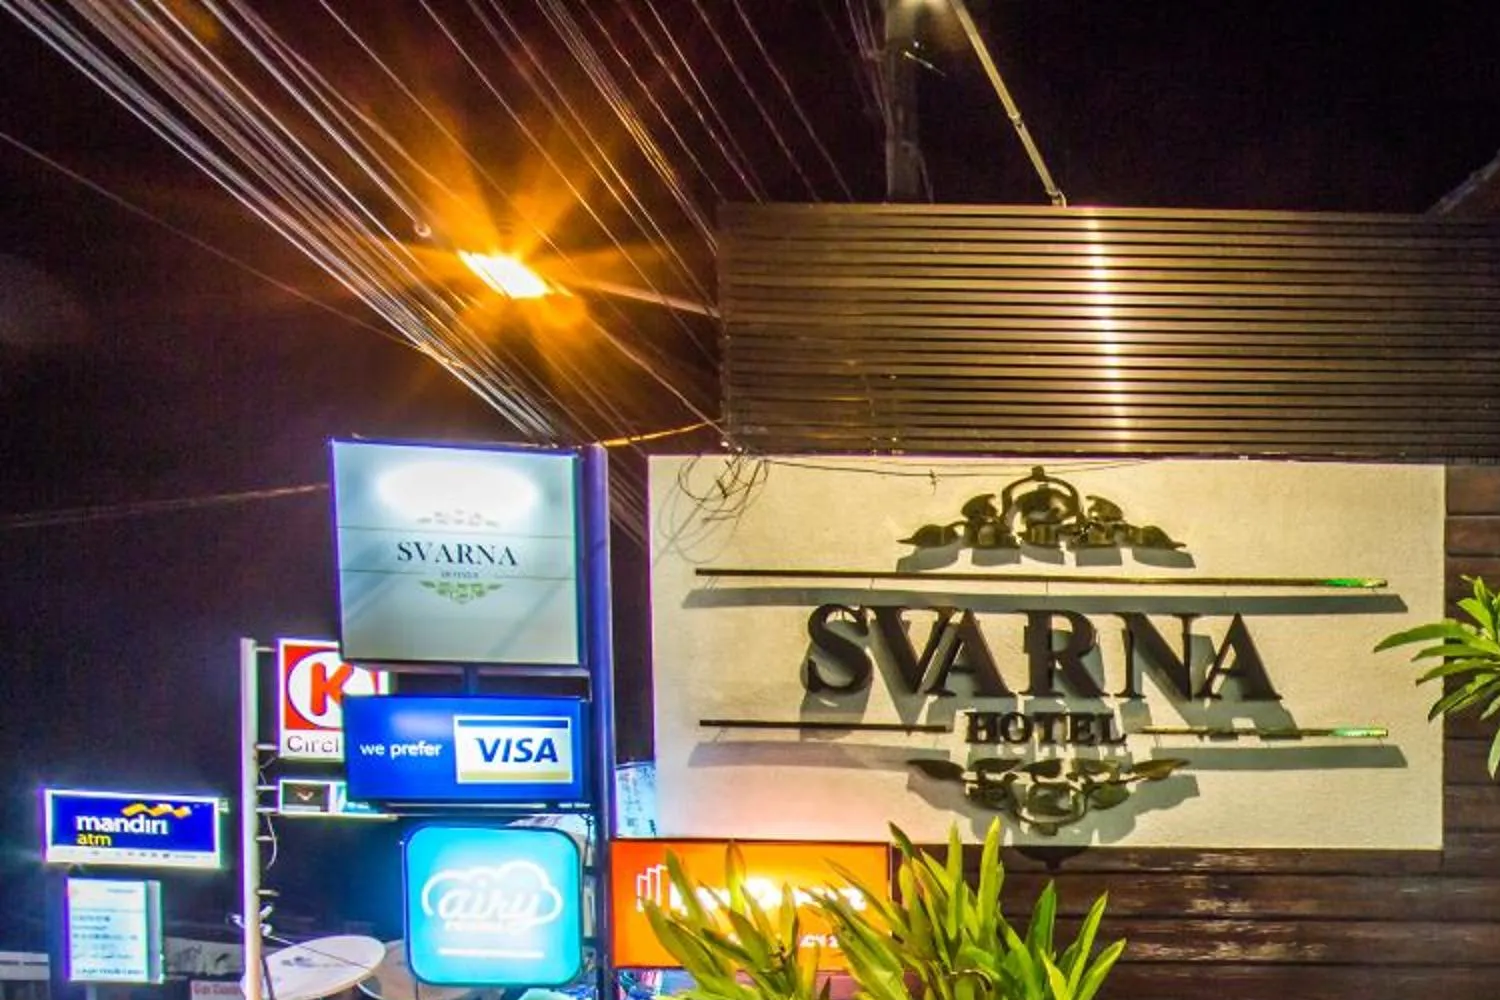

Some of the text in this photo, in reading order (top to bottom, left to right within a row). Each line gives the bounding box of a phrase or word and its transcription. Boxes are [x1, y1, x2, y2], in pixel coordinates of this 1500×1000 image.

[396, 541, 519, 566] SVARNA
[806, 602, 1284, 702] SVARNA
[964, 711, 1127, 747] HOTEL
[287, 735, 340, 753] Circl
[359, 739, 443, 760] we prefer
[475, 737, 559, 763] VISA
[75, 812, 169, 835] mandiri
[76, 832, 112, 846] atm
